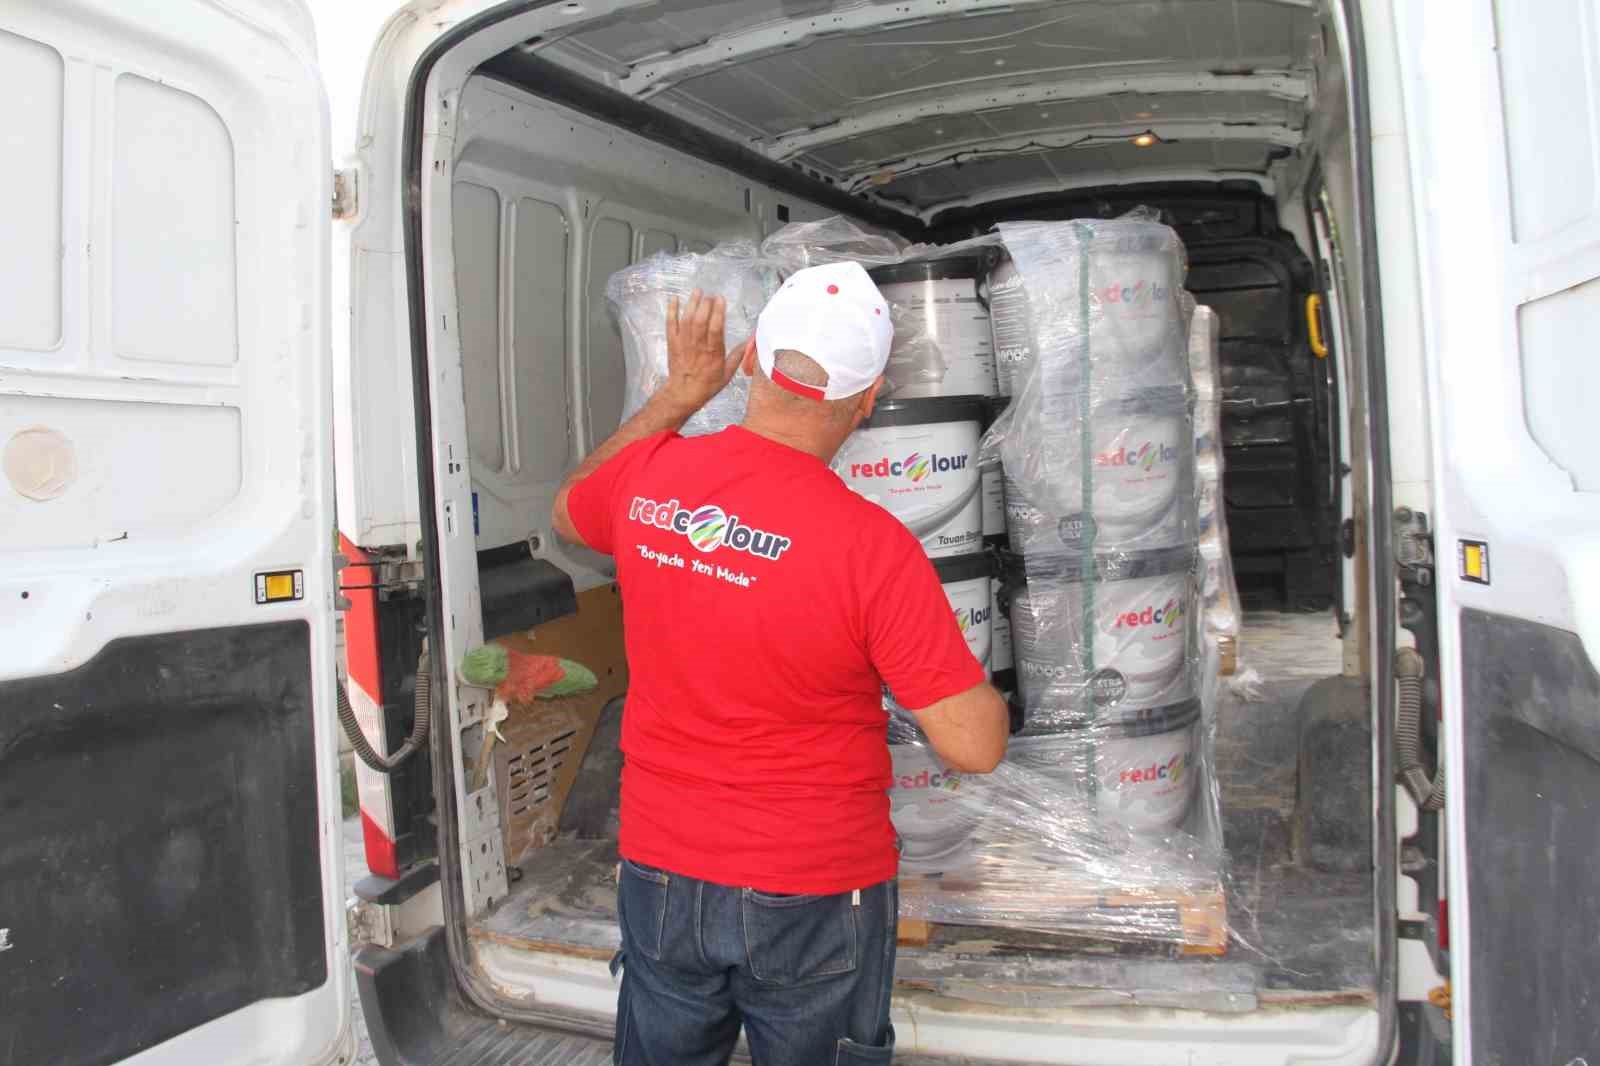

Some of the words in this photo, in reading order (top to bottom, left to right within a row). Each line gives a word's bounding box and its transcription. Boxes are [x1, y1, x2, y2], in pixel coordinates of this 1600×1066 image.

[851, 452, 968, 482] redcolour
[629, 497, 791, 560] redcolour
[691, 559, 714, 577] Yeni
